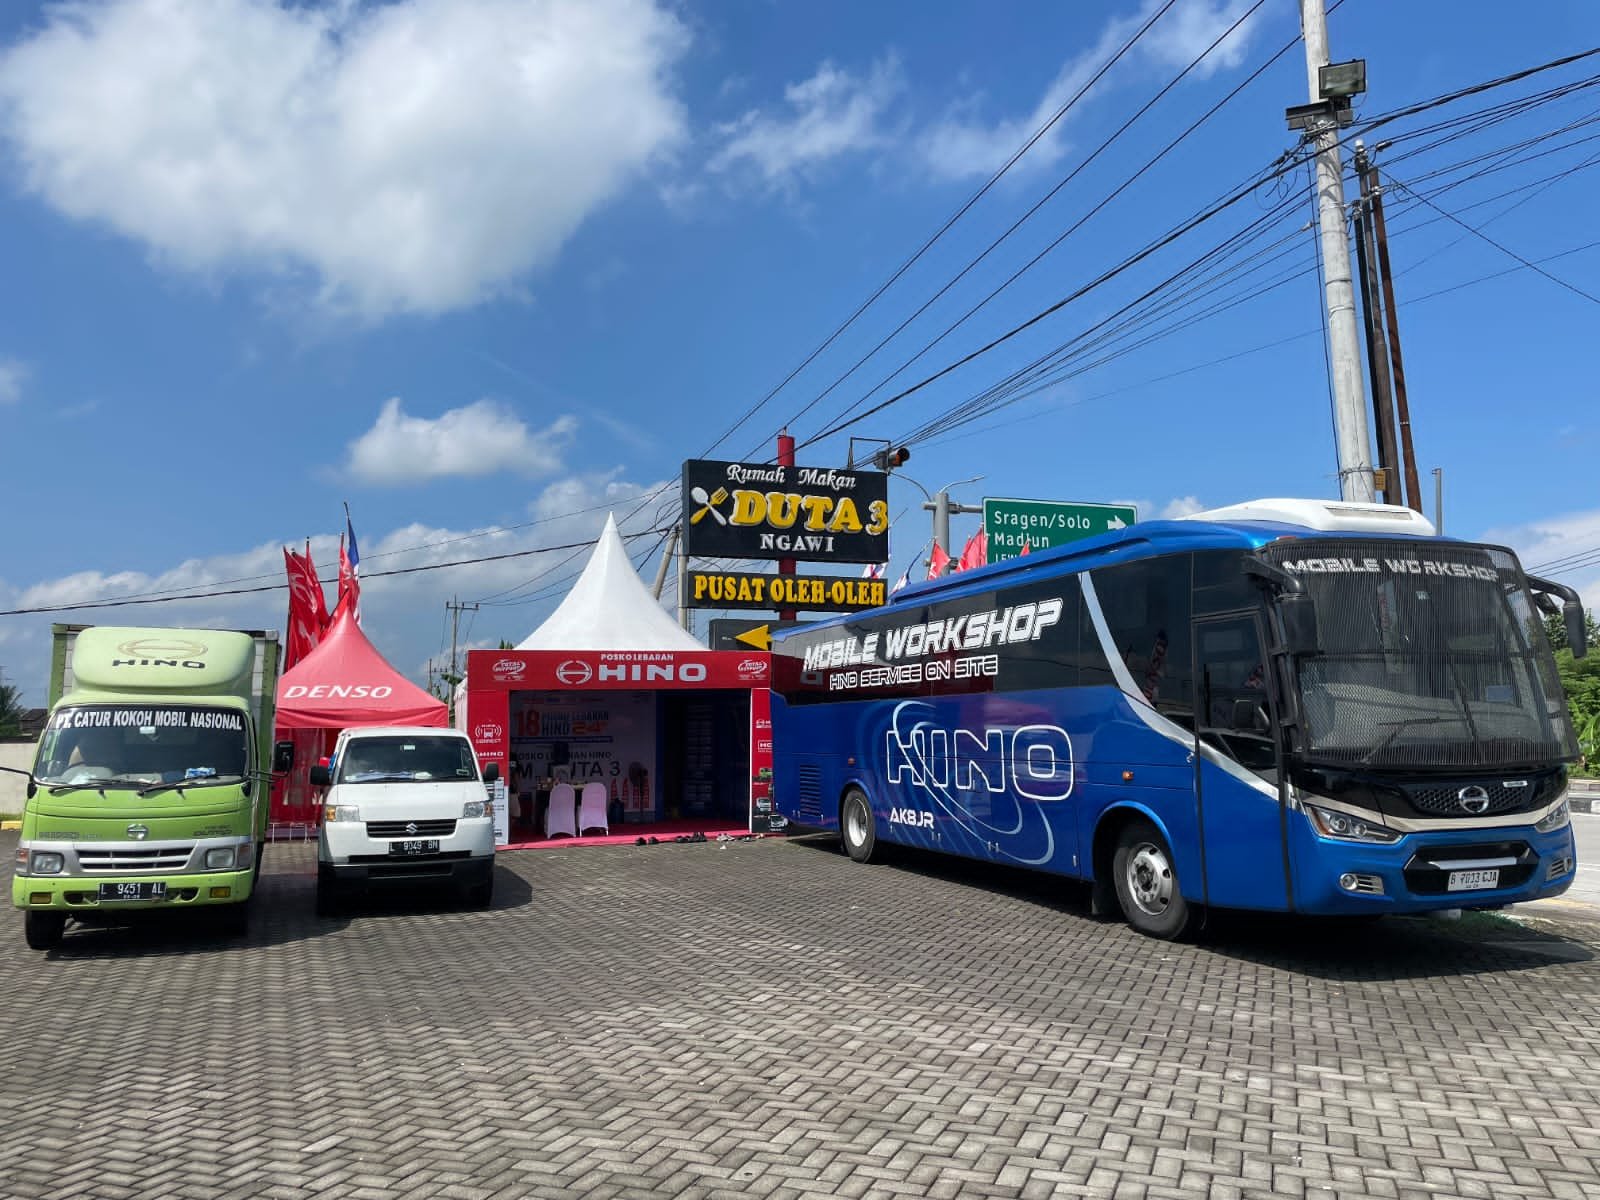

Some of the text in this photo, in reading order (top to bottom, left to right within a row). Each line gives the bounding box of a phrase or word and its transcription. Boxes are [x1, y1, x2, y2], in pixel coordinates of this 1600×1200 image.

[727, 464, 856, 491] Rumah Makan
[728, 489, 888, 536] DUTA 3
[994, 510, 1091, 529] Sragen/Solo
[760, 533, 834, 552] NGAWI
[1282, 557, 1500, 582] MOBILE WORKSHOP
[694, 575, 885, 606] PUSAT OLEH-OLEH
[803, 597, 1064, 673] MOBILE WORKSHOP
[112, 659, 205, 669] HINO
[599, 663, 707, 681] HINO
[829, 655, 998, 691] HINO SERVICE ON SITE
[284, 686, 392, 698] DENSO
[56, 710, 242, 730] PT. CATUR KOKOH MOBIL NASIONAL
[516, 710, 540, 737] 18
[887, 724, 1074, 801] HINO
[101, 882, 164, 895] L 9451 AL
